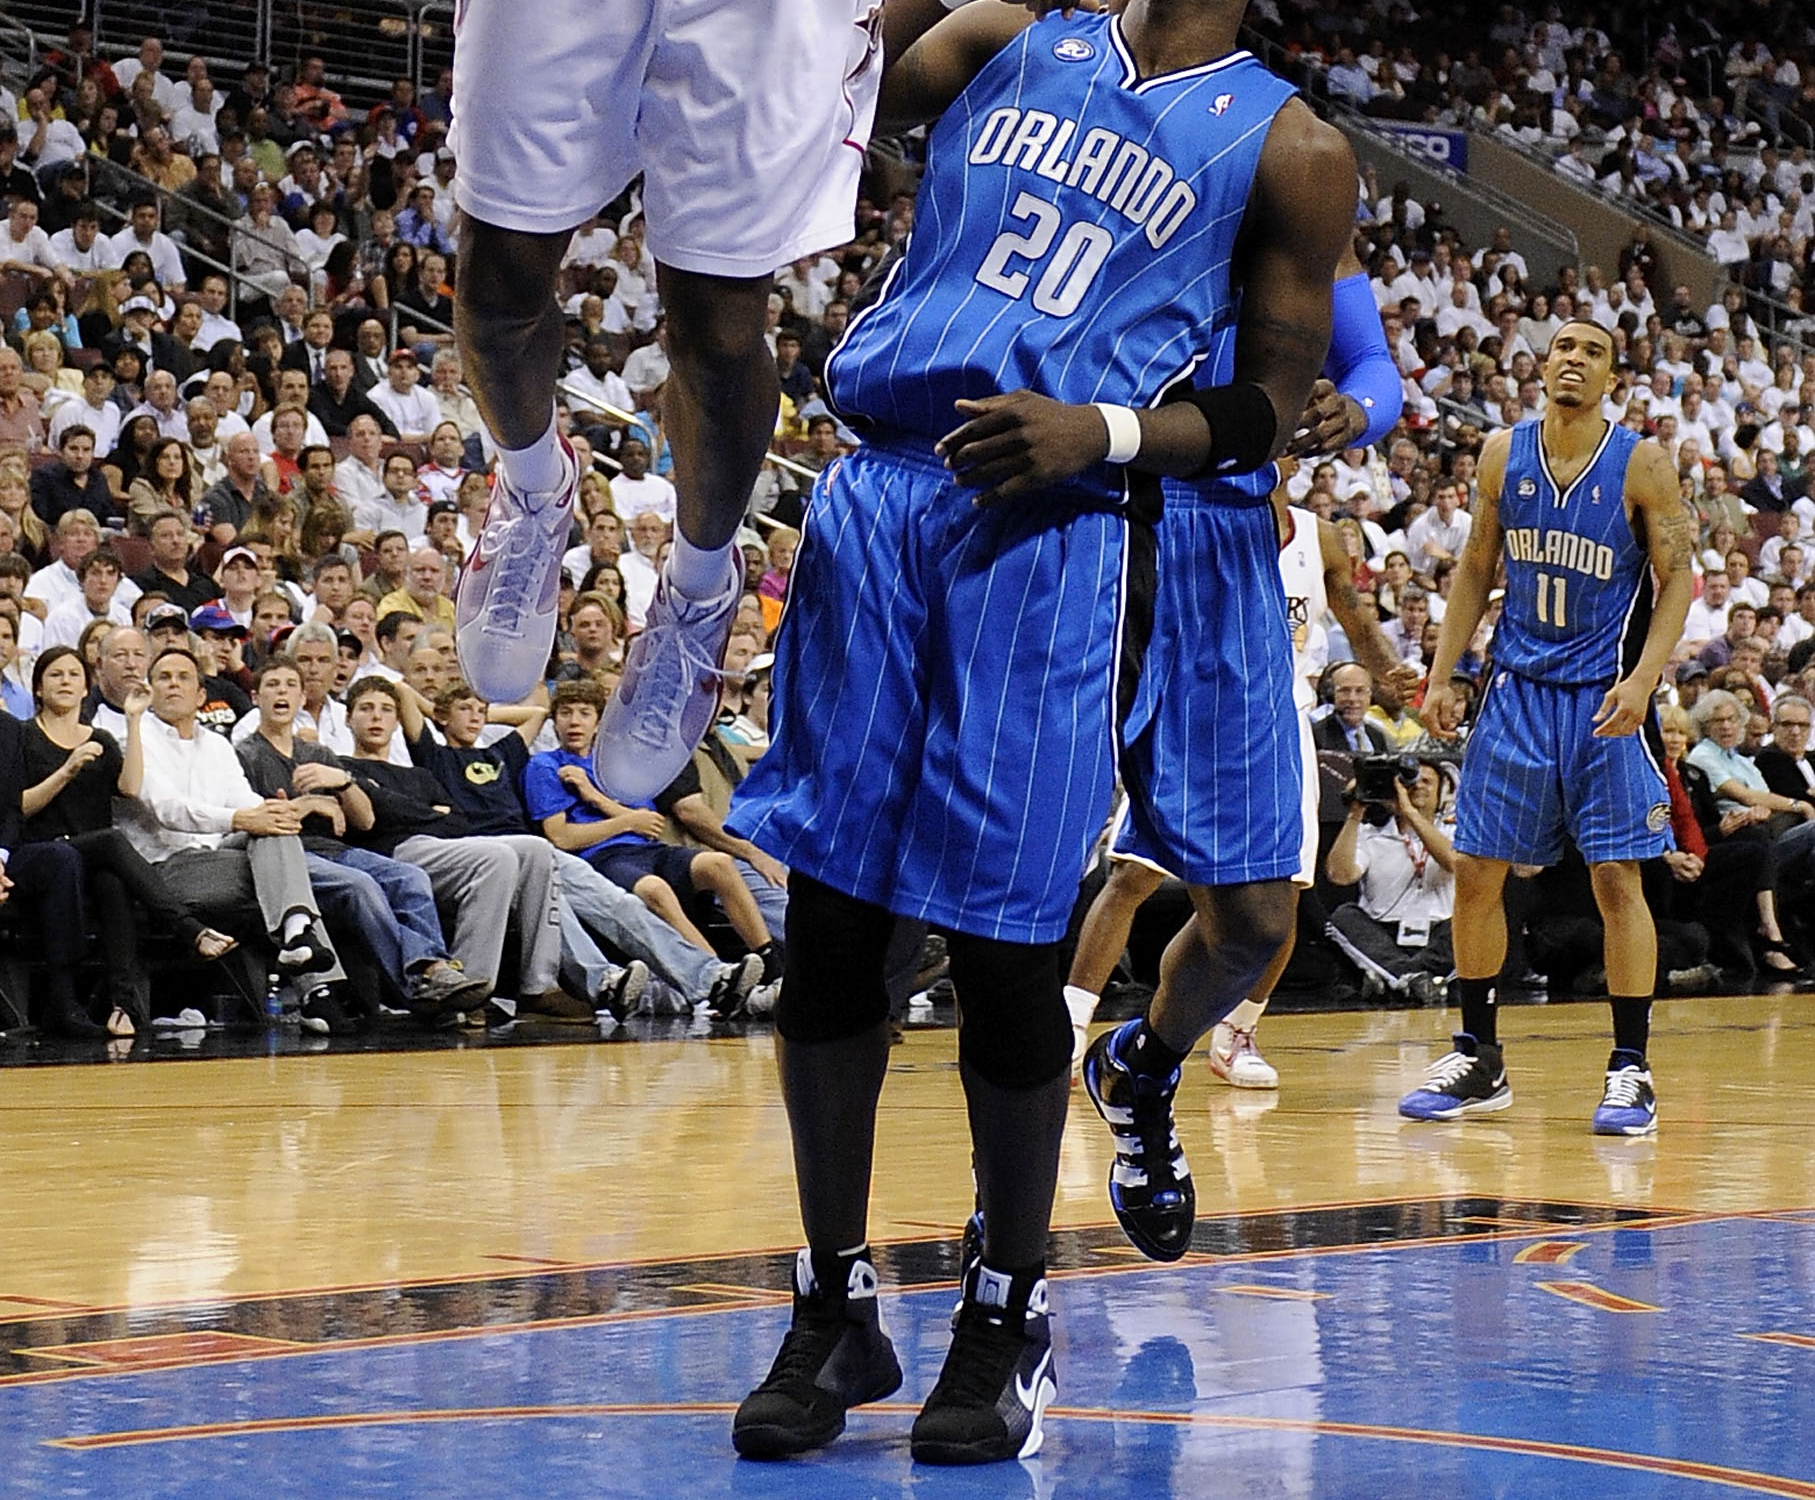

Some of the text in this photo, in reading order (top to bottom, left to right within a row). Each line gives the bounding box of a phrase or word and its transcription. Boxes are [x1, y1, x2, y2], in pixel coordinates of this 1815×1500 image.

[968, 108, 1196, 250] ORLANDO
[975, 191, 1114, 318] 20
[1505, 528, 1614, 581] ORLANDO
[1536, 572, 1567, 628] 11
